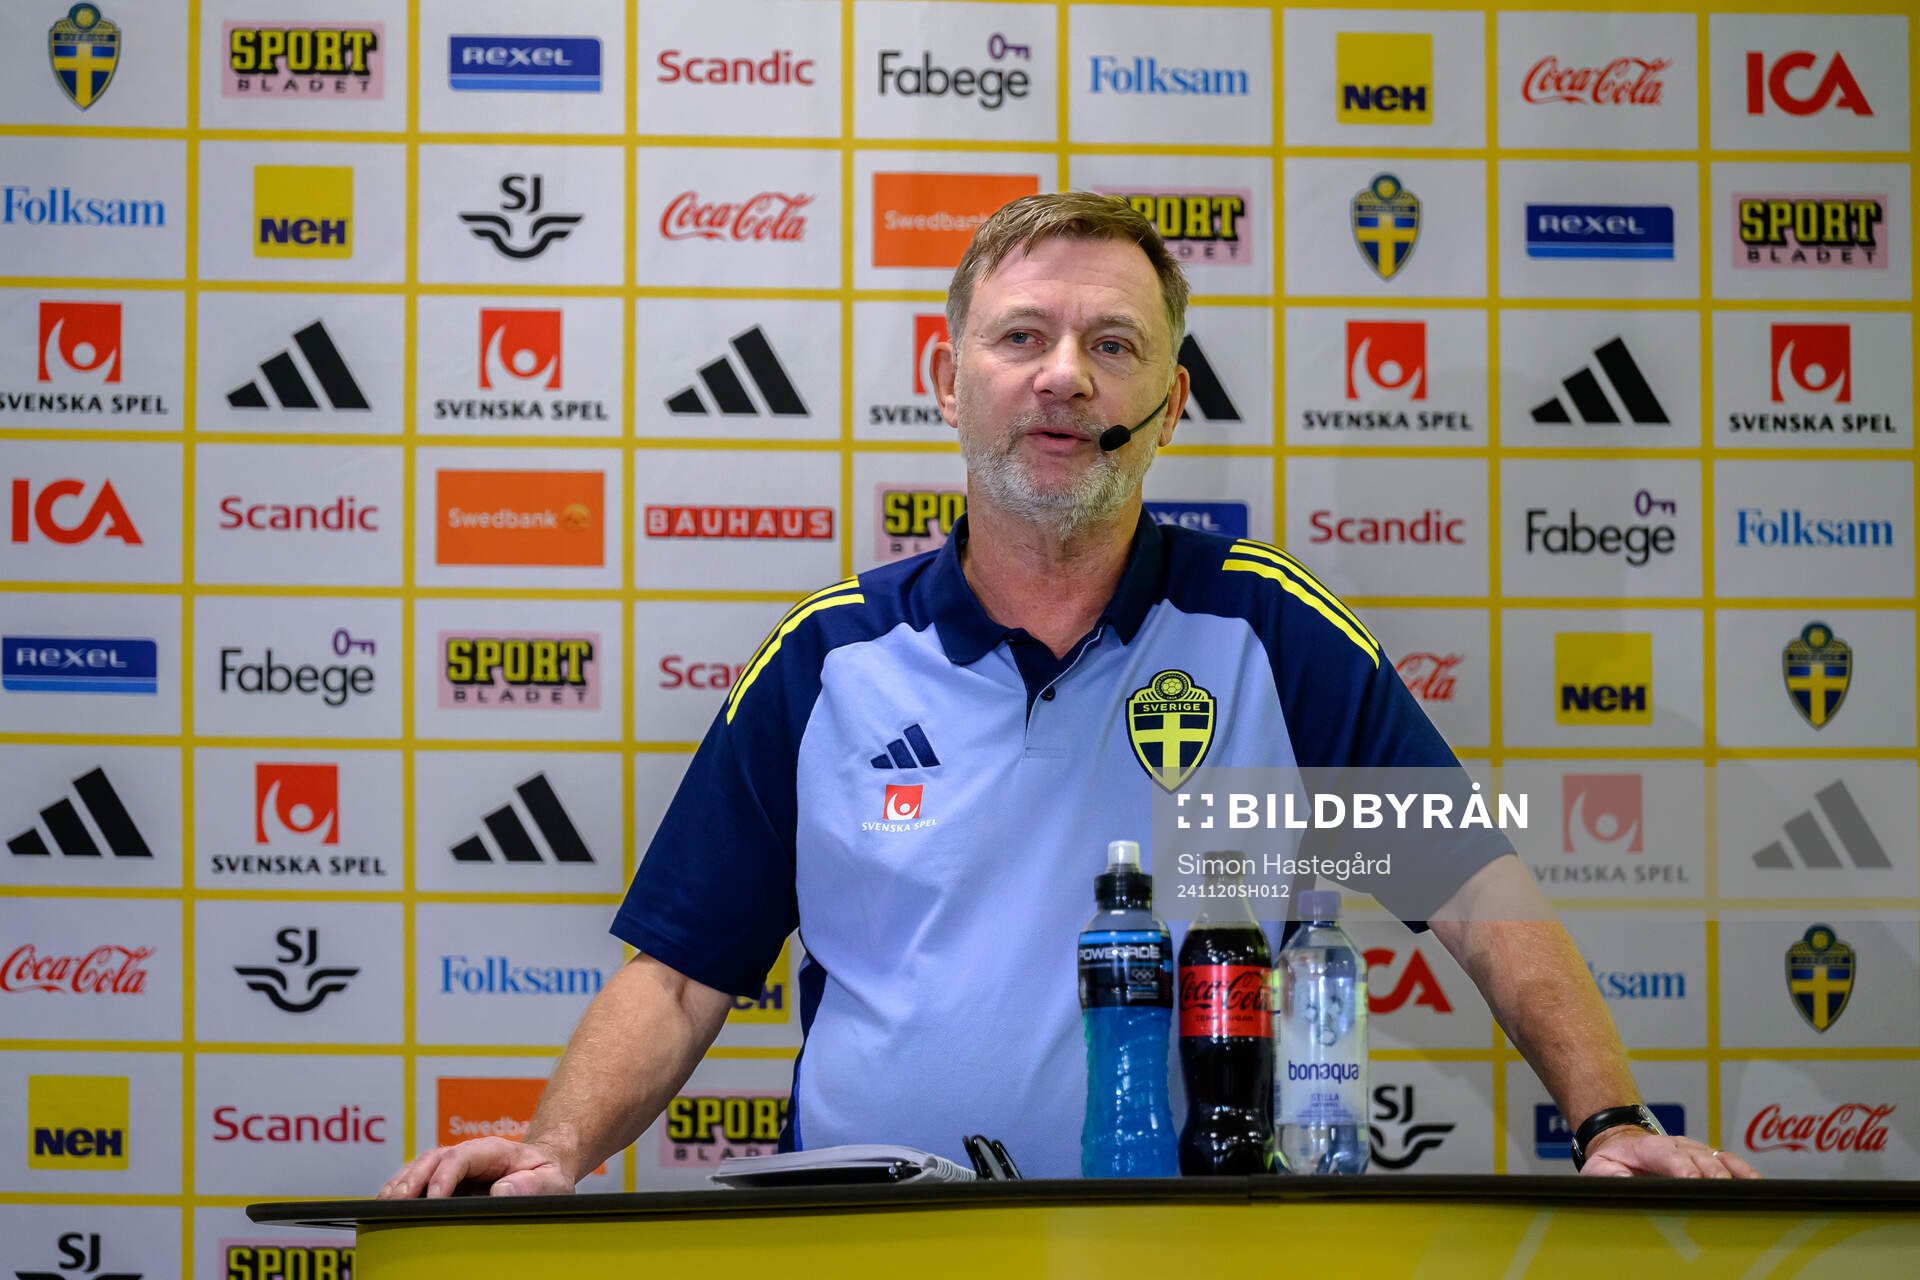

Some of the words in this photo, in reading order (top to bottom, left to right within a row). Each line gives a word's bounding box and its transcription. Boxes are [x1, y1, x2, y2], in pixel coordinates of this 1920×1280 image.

[230, 28, 378, 76] SPORT
[657, 50, 815, 86] Scandic
[238, 78, 371, 94] BLADET
[879, 51, 1031, 111] Fabege
[1090, 56, 1249, 96] Folksam
[1522, 55, 1672, 106] Coca-Cola
[1746, 51, 1874, 117] ICA
[3, 186, 165, 227] Folksam
[500, 174, 543, 213] SJ
[659, 190, 815, 242] Coca-Cola
[1740, 199, 1882, 247] SPORT
[1747, 248, 1876, 264] BLADET
[112, 394, 168, 414] SPEL
[435, 399, 544, 419] SVENSKA
[551, 401, 608, 420] SPEL
[1303, 410, 1410, 431] SVENSKA
[1417, 412, 1472, 431] SPEL
[1729, 413, 1835, 433] SVENSKA
[1842, 413, 1896, 433] SPEL
[11, 478, 143, 545] ICA
[220, 496, 378, 531] Scandic
[448, 506, 557, 529] Swedbank
[648, 509, 832, 536] BAUHAUS
[1310, 510, 1464, 545] Scandic
[1737, 509, 1894, 547] Folksam
[1526, 508, 1676, 567] Fabege
[220, 648, 375, 706] Fabege
[446, 638, 593, 687] SPORT
[454, 688, 588, 704] BLADET
[1143, 703, 1201, 712] SVERIGE
[862, 822, 911, 833] SVENSKA
[913, 818, 938, 830] SPEL
[212, 855, 321, 875] SVENSKA
[330, 857, 386, 876] SPEL
[1634, 865, 1689, 884] SPEL
[276, 927, 318, 967] SJ
[0, 944, 155, 995] Coca-Cola
[440, 955, 603, 994] Folksam
[1288, 1060, 1359, 1084] bonaqua
[1373, 1084, 1414, 1123] SJ
[213, 1106, 386, 1143] Scandic
[1744, 1103, 1898, 1153] Coca-Cola
[57, 1232, 99, 1272] SJ
